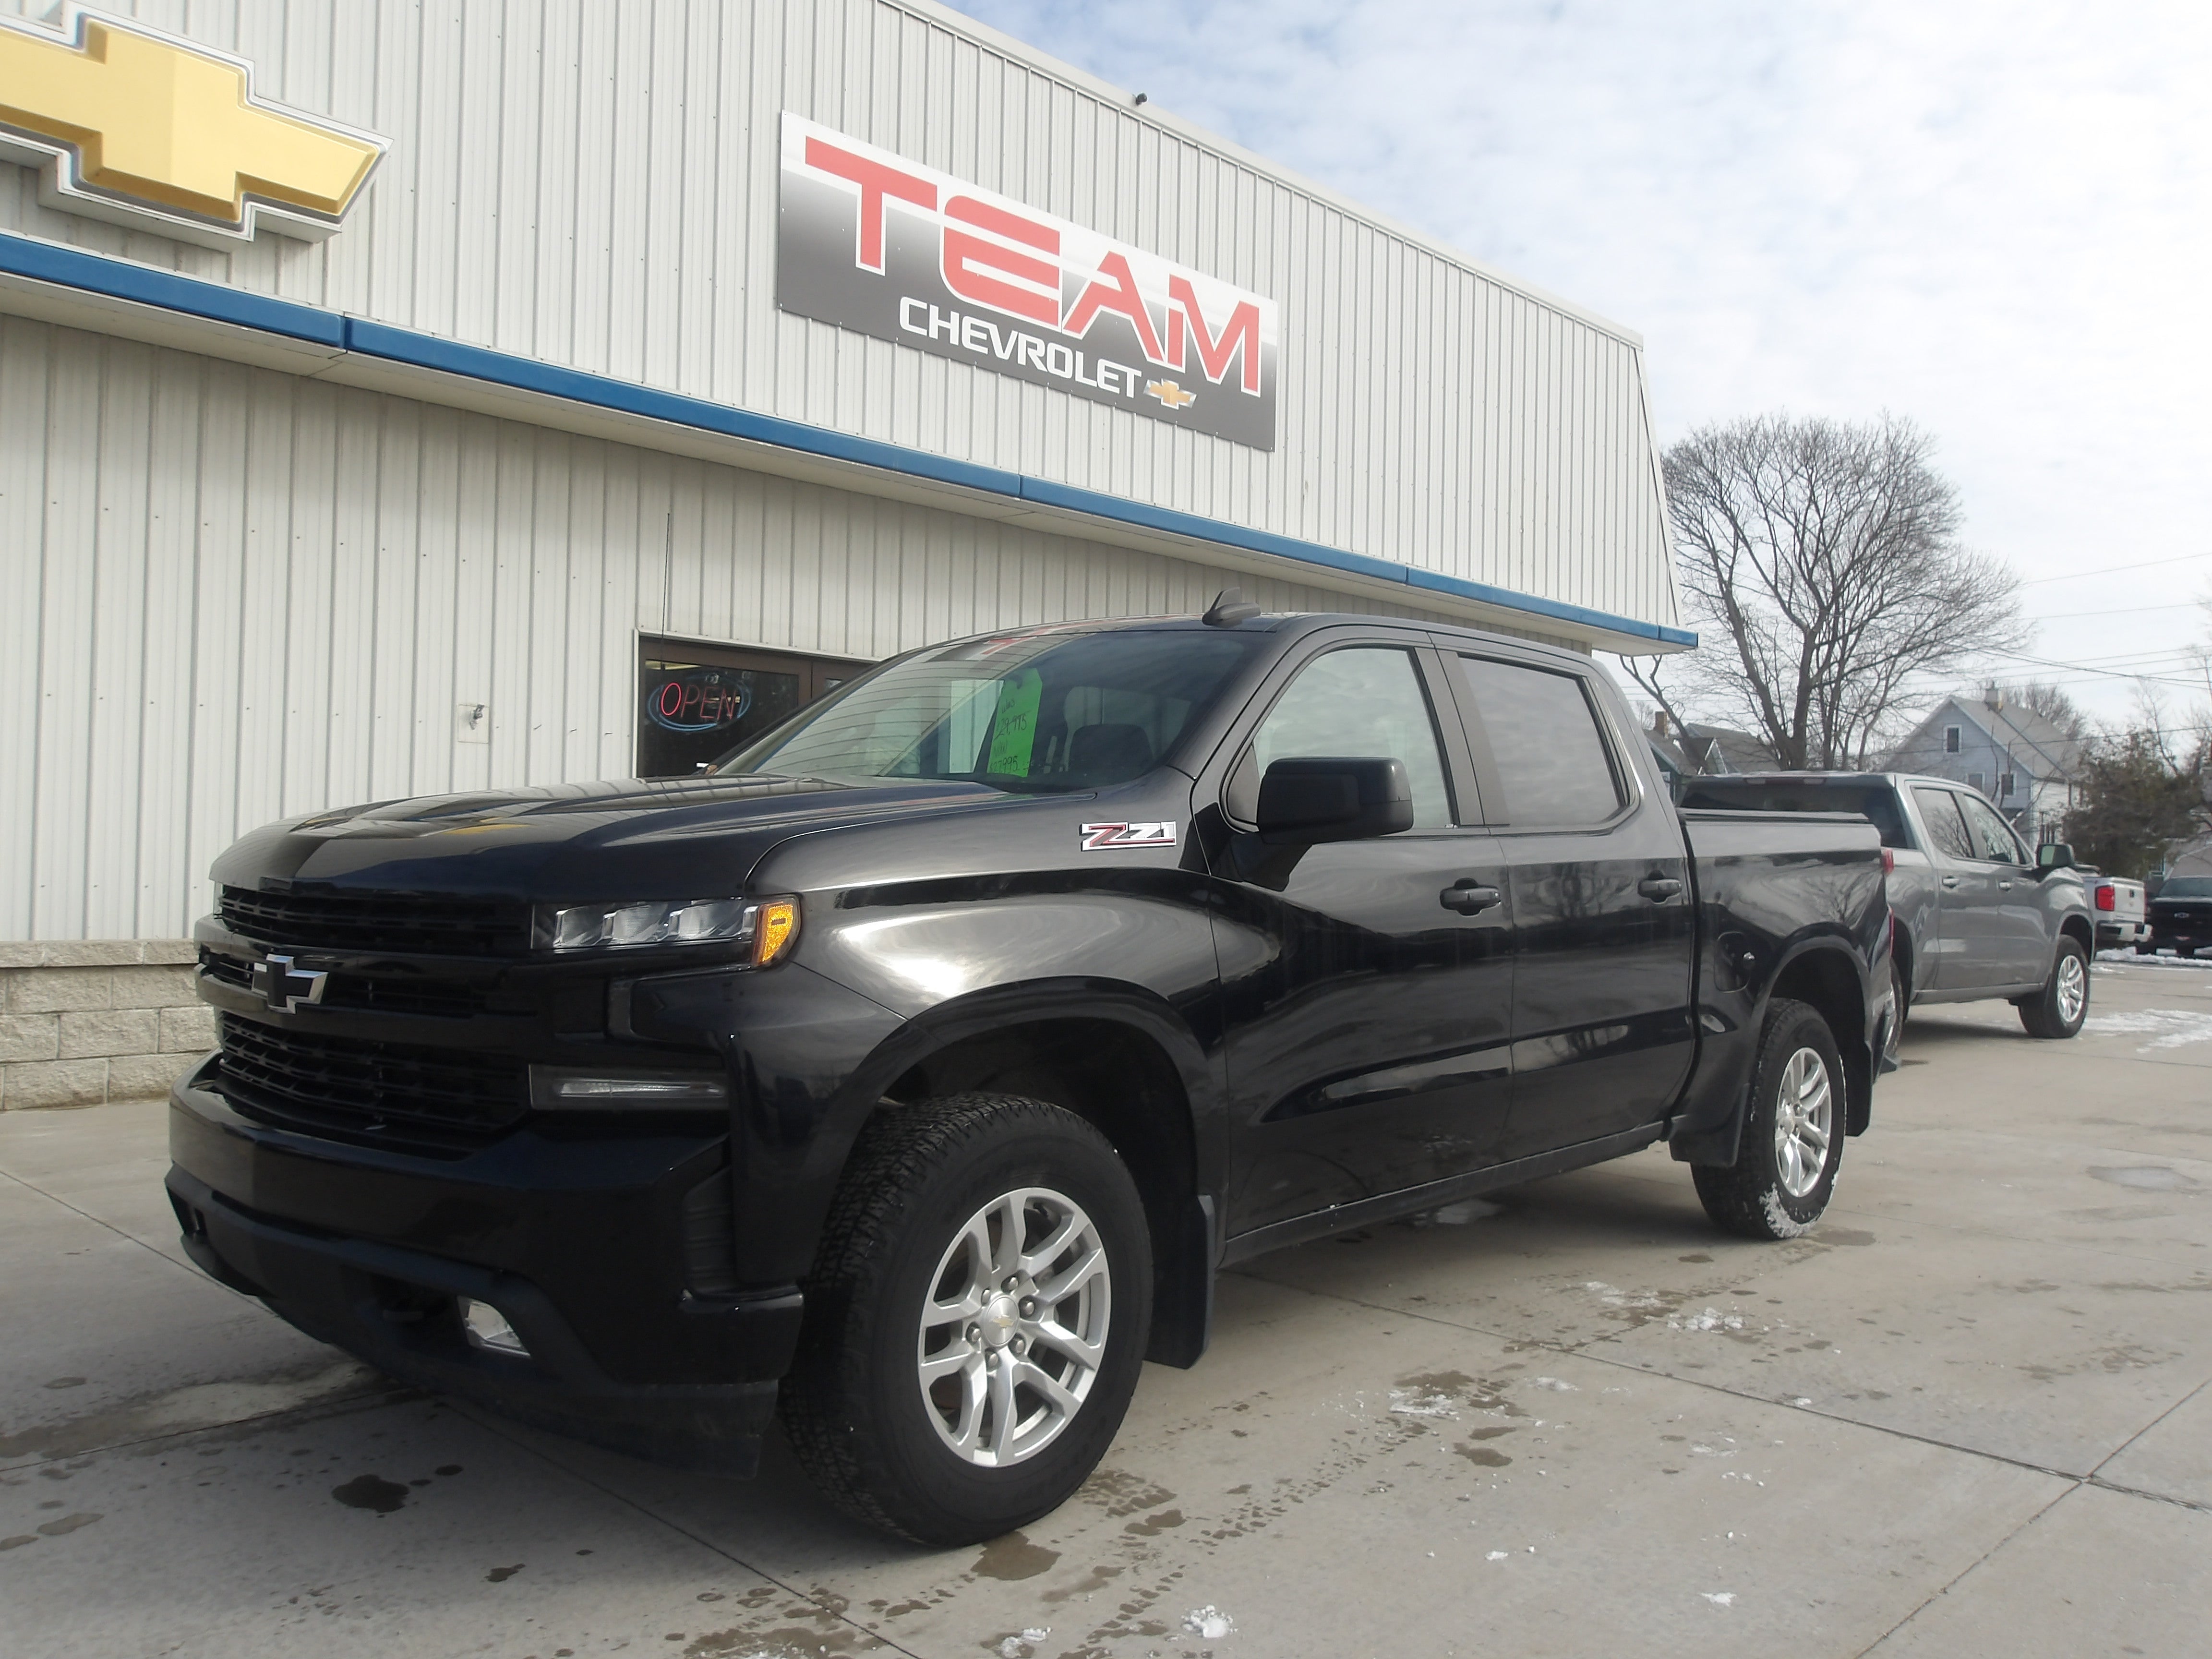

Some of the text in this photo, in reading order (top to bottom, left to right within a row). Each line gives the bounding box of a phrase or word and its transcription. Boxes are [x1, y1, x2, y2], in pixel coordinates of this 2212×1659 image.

[804, 135, 1261, 397] TEAM
[899, 296, 1142, 398] CHEVROLET
[661, 683, 737, 720] OPEN
